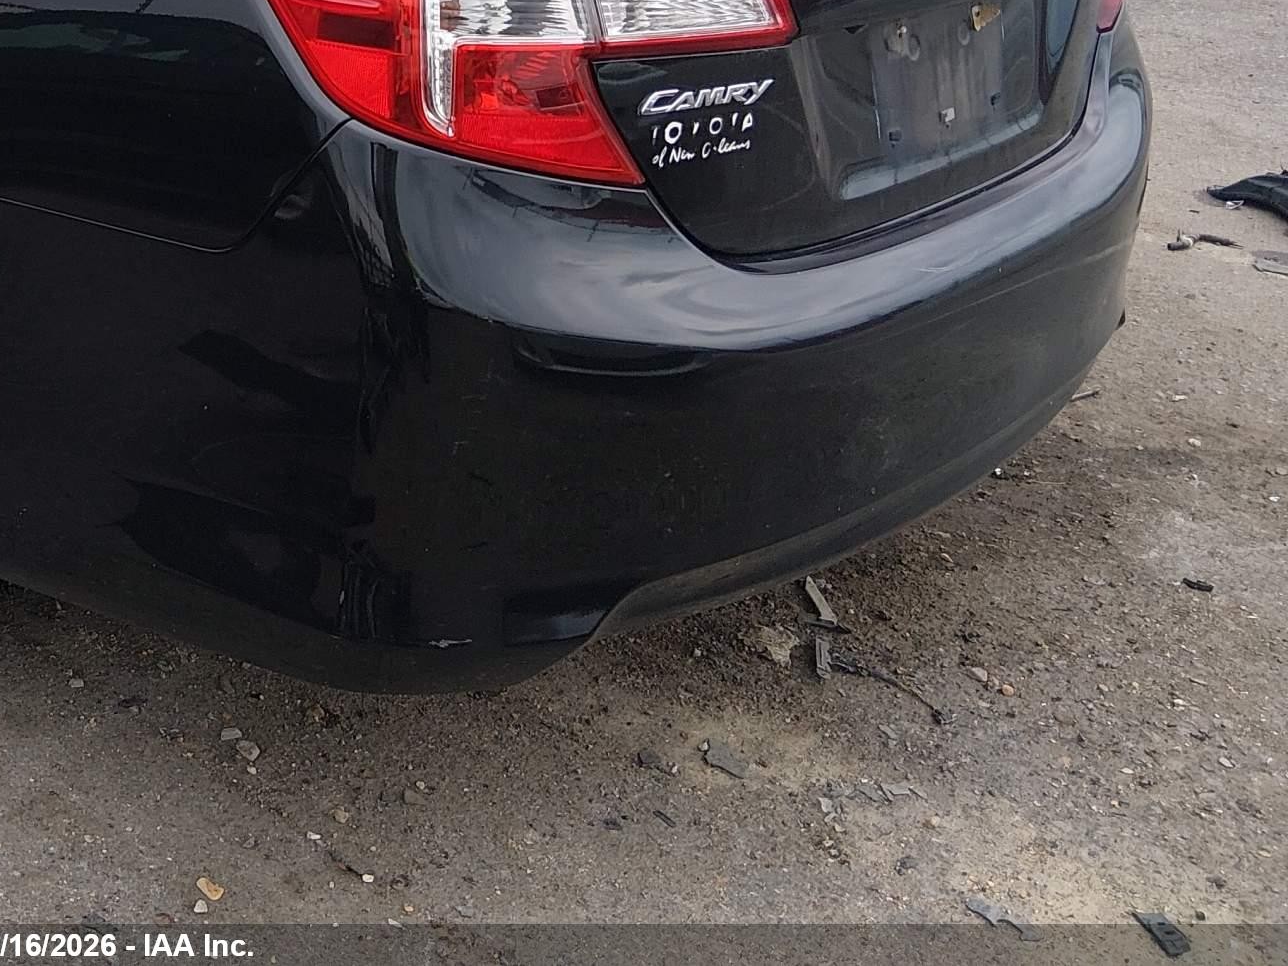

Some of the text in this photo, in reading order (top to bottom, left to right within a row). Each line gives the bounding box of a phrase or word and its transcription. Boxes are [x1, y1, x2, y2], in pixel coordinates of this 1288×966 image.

[639, 79, 775, 115] CAMRY
[651, 146, 668, 169] of
[701, 137, 751, 159] Oleans
